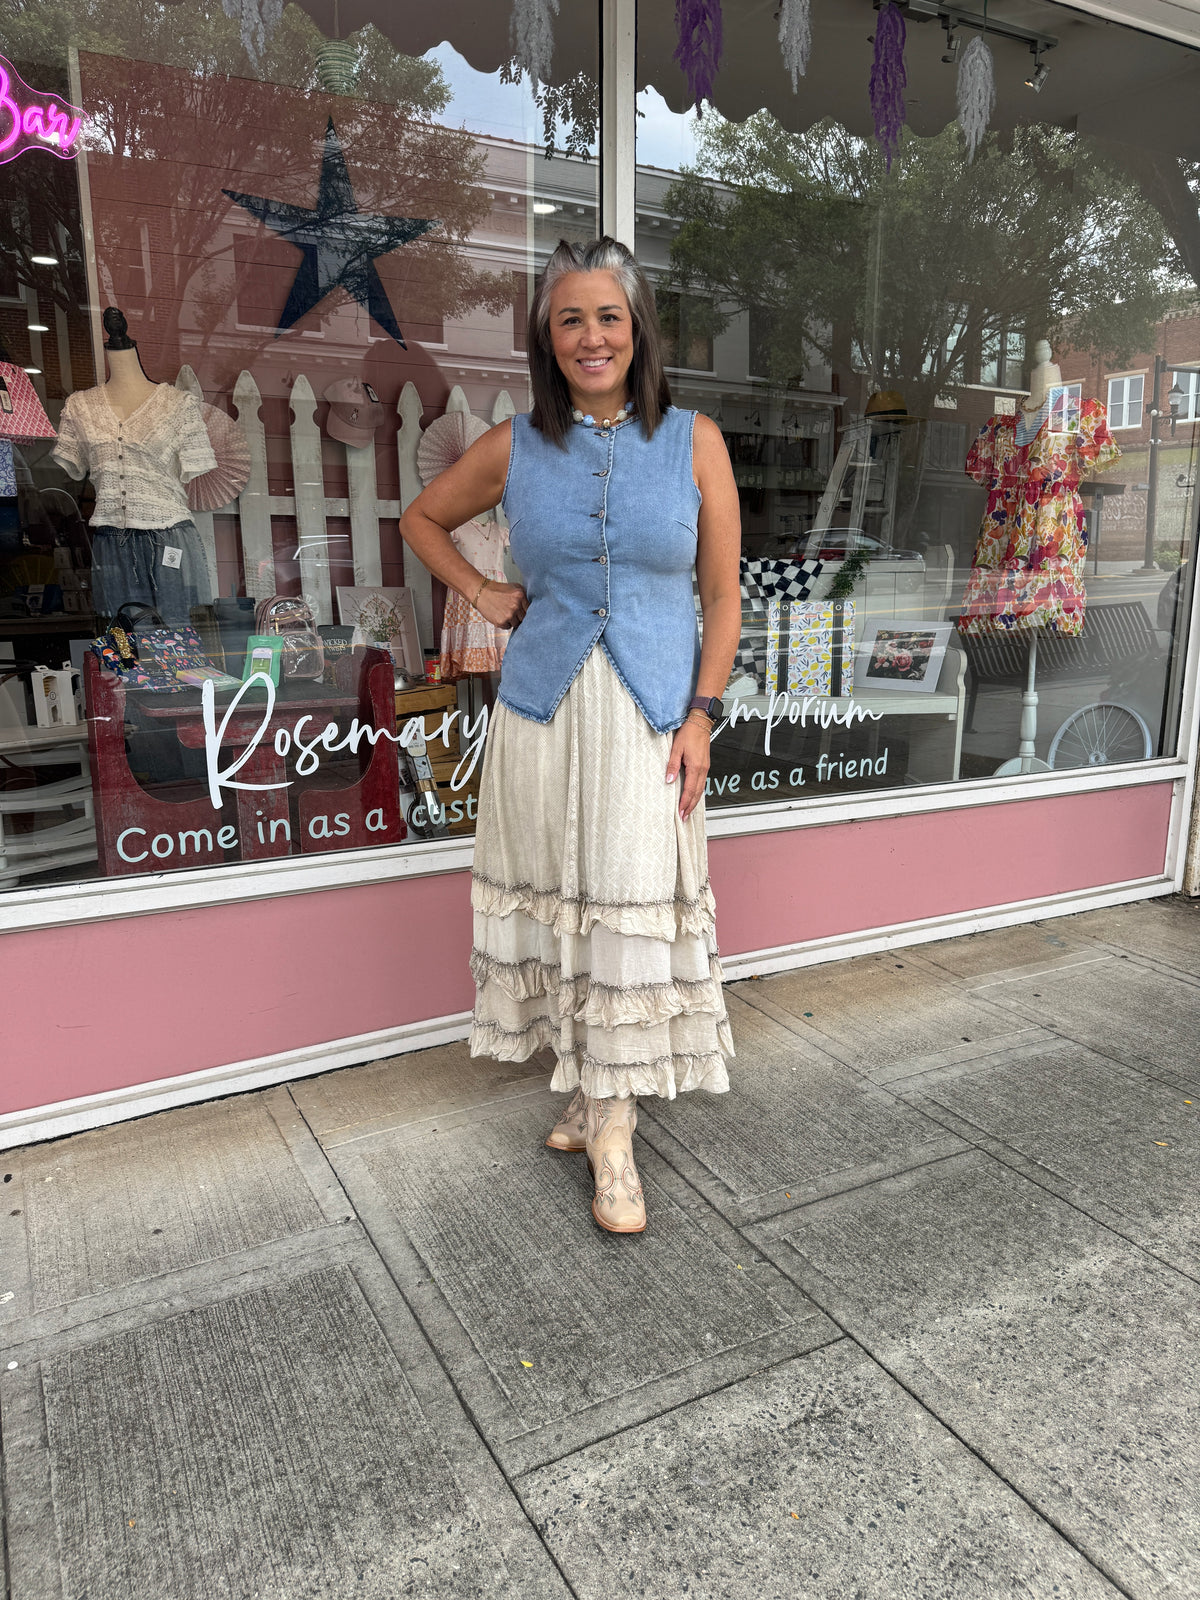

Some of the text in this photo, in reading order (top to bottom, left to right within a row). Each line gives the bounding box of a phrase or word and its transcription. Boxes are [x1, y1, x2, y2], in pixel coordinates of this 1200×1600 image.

[201, 672, 884, 809] Rosemary mporium
[116, 827, 239, 863] Come
[256, 810, 291, 844] in
[308, 811, 350, 839] as
[365, 807, 388, 833] a
[411, 794, 478, 828] cust
[751, 770, 780, 791] as
[789, 767, 806, 786] a
[816, 748, 888, 782] friend
